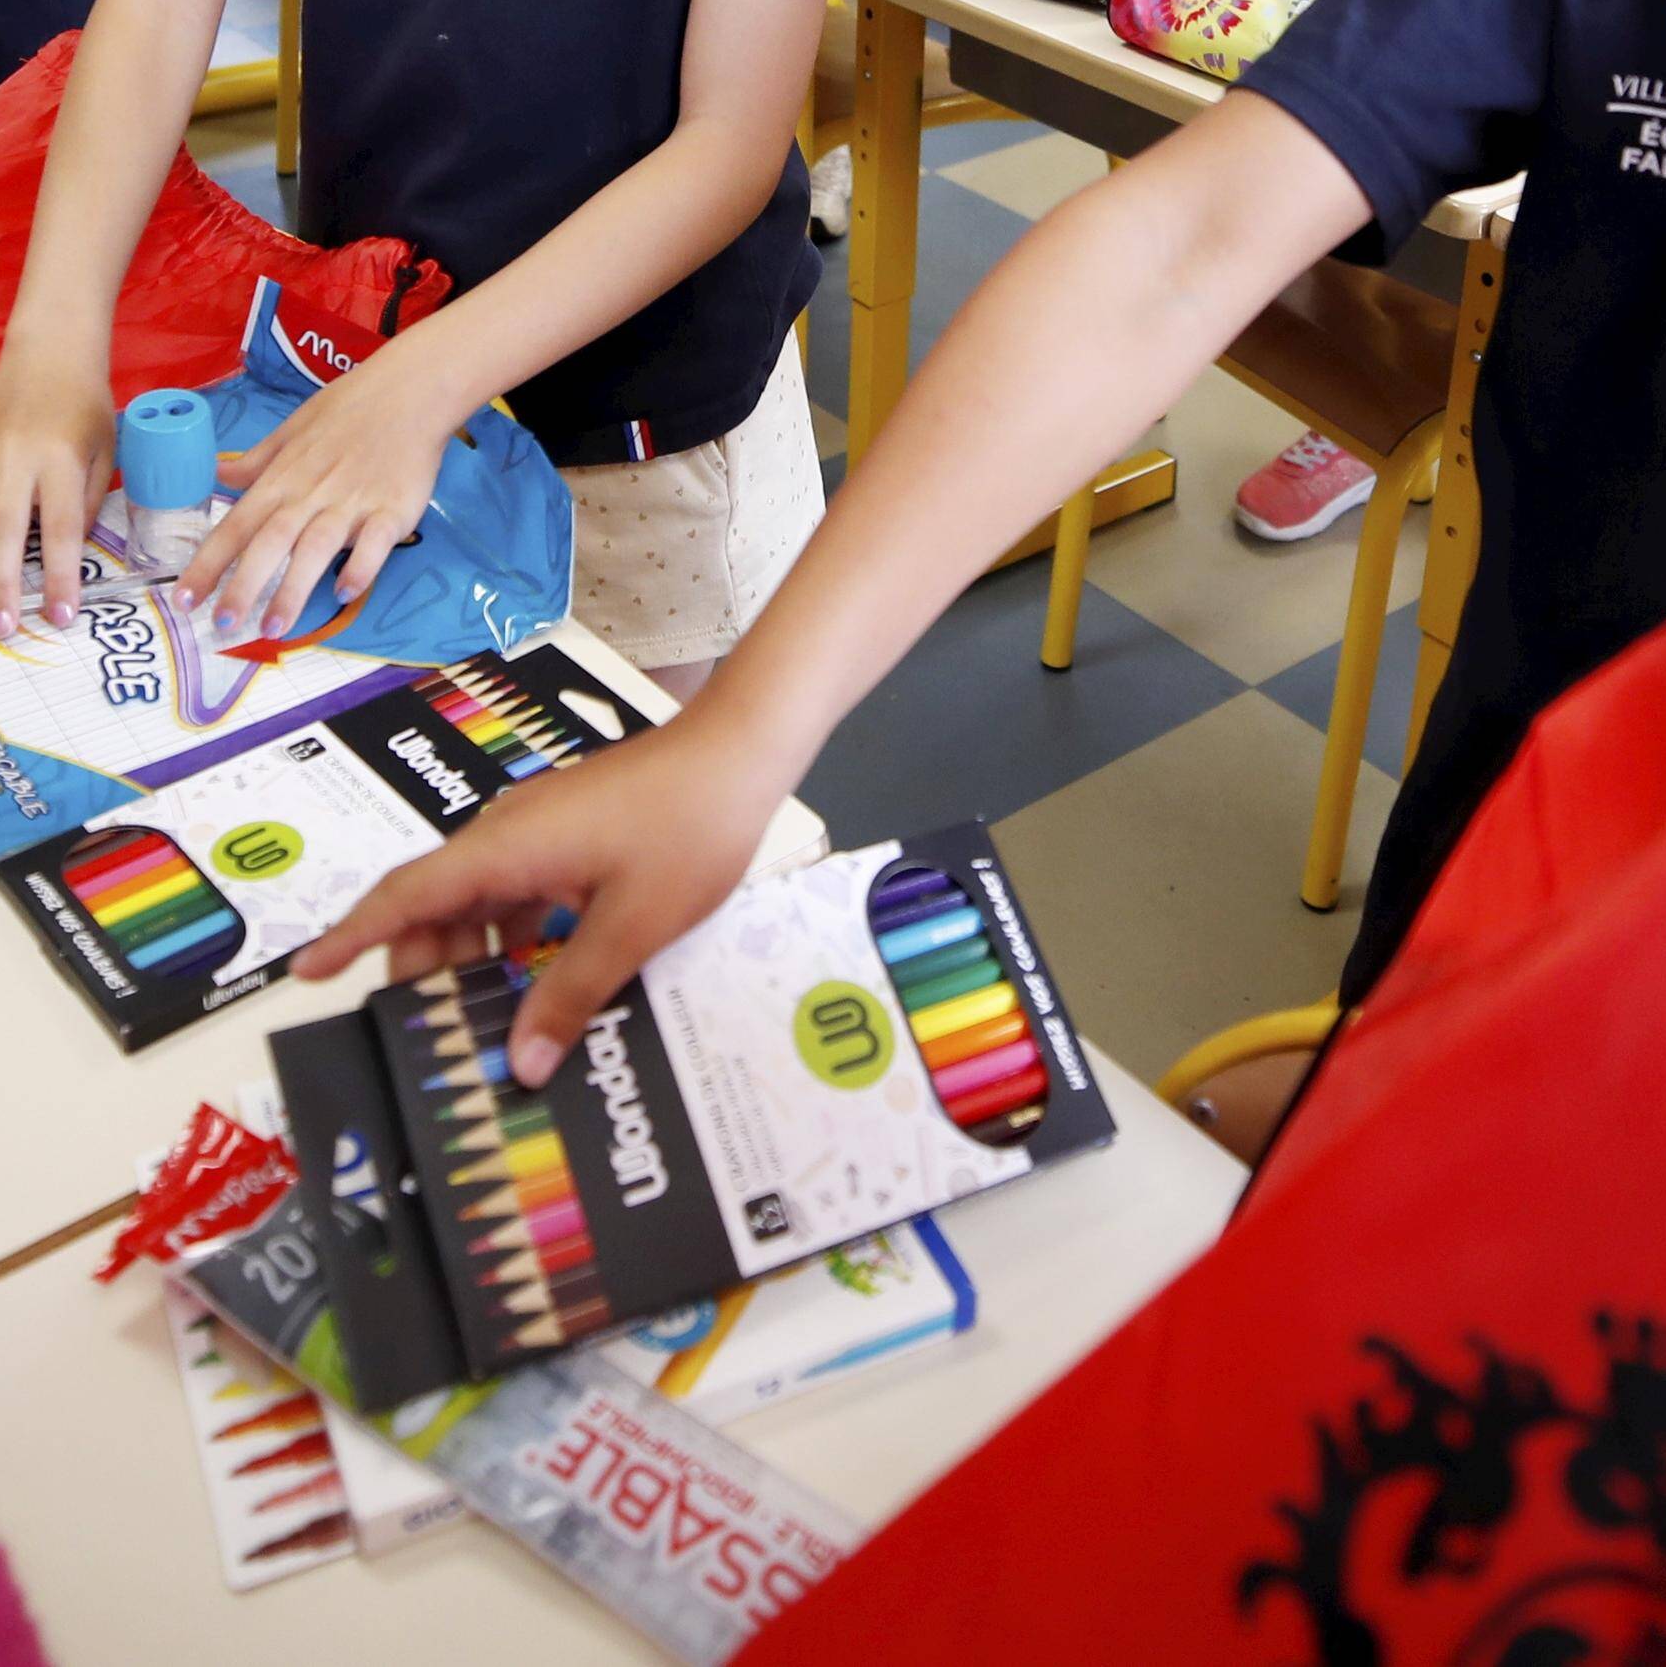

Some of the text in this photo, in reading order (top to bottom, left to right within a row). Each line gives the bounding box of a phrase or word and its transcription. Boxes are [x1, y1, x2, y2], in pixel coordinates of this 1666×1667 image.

[297, 330, 361, 372] Ma
[81, 600, 160, 706] ABLE
[387, 727, 481, 816] Wonday
[201, 972, 269, 1011] Wonday
[584, 1005, 670, 1209] Wonday
